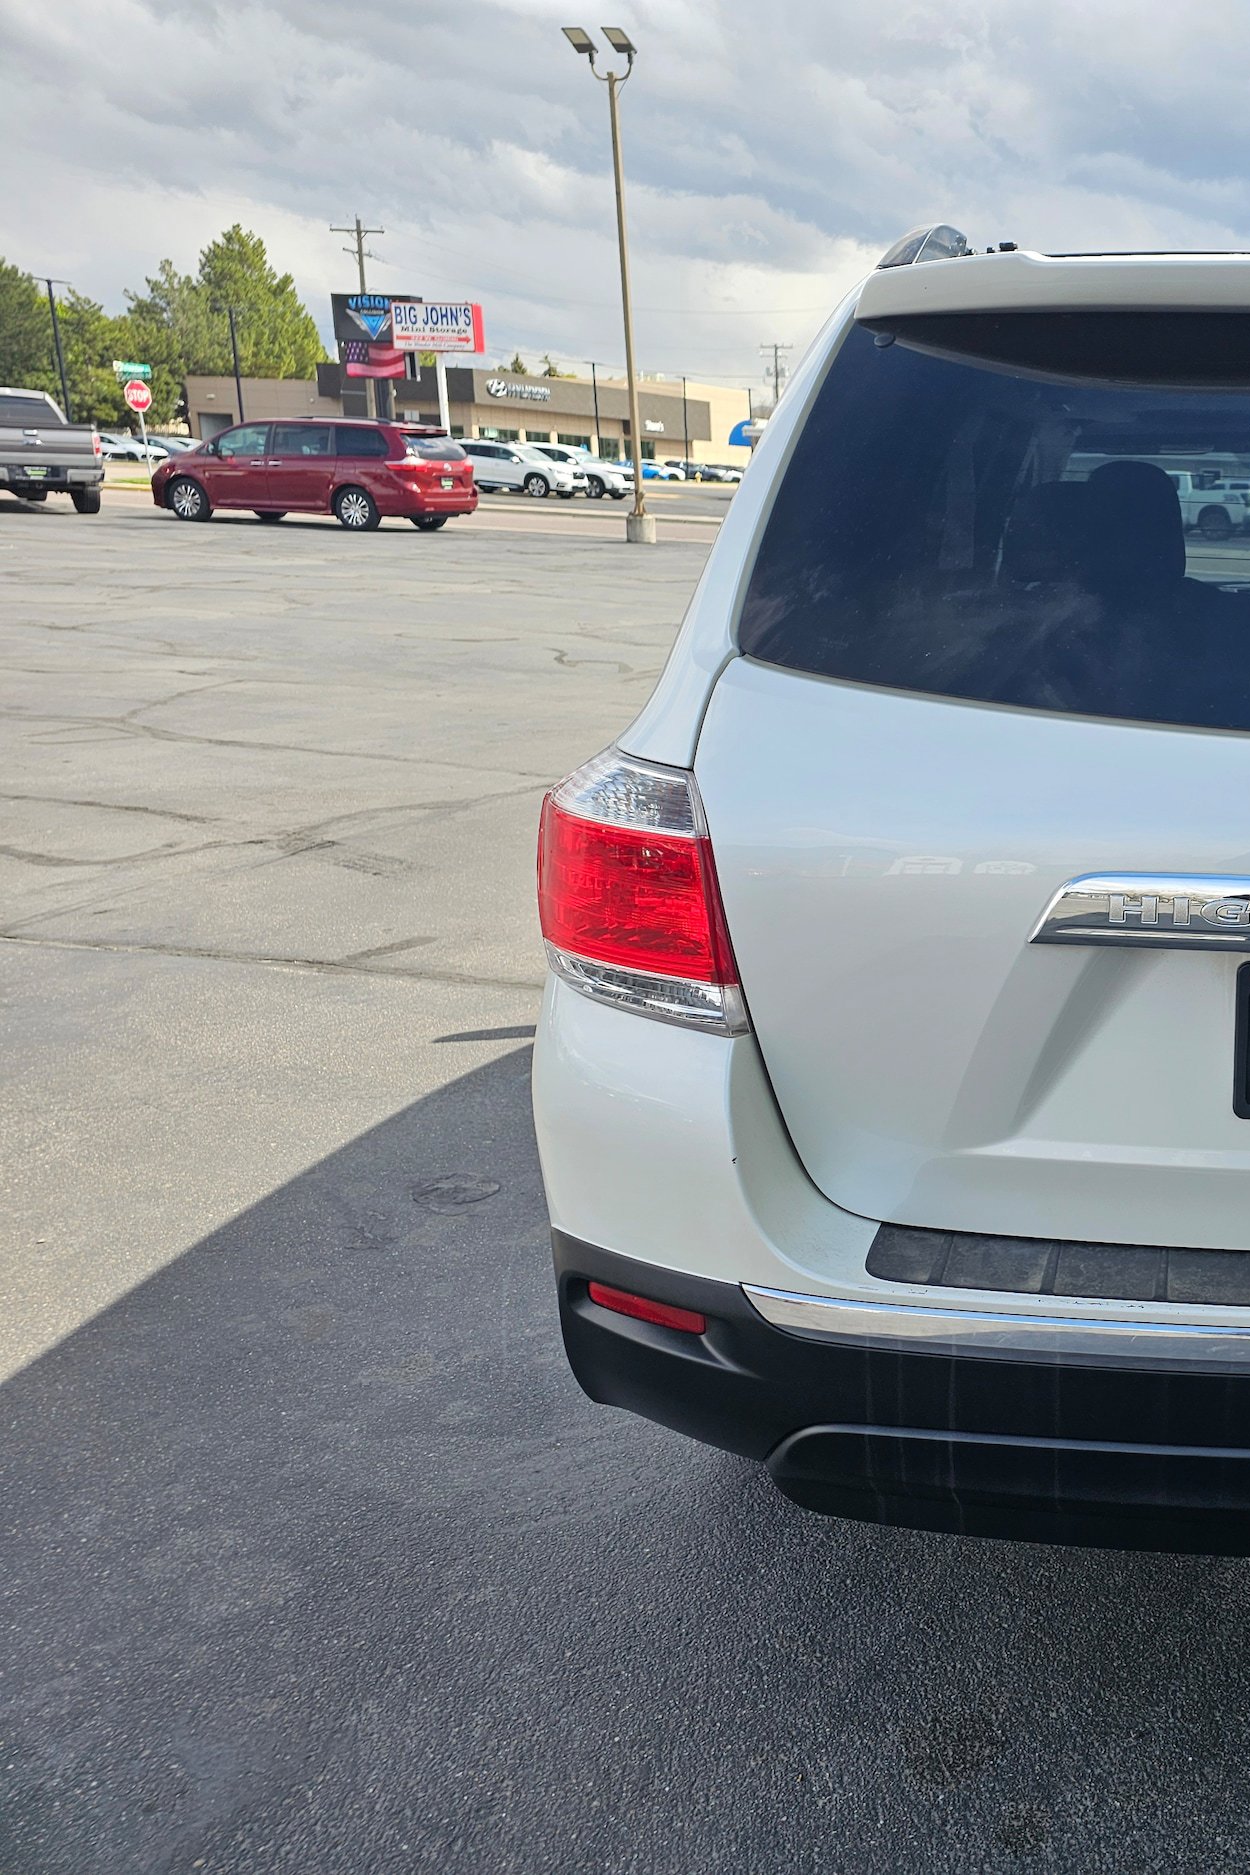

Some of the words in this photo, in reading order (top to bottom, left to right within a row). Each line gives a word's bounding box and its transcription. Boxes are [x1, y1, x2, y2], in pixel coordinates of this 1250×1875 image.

[394, 306, 417, 325] BIG
[422, 306, 471, 326] JOHN'S
[429, 326, 467, 335] Storage
[127, 389, 149, 402] STOP
